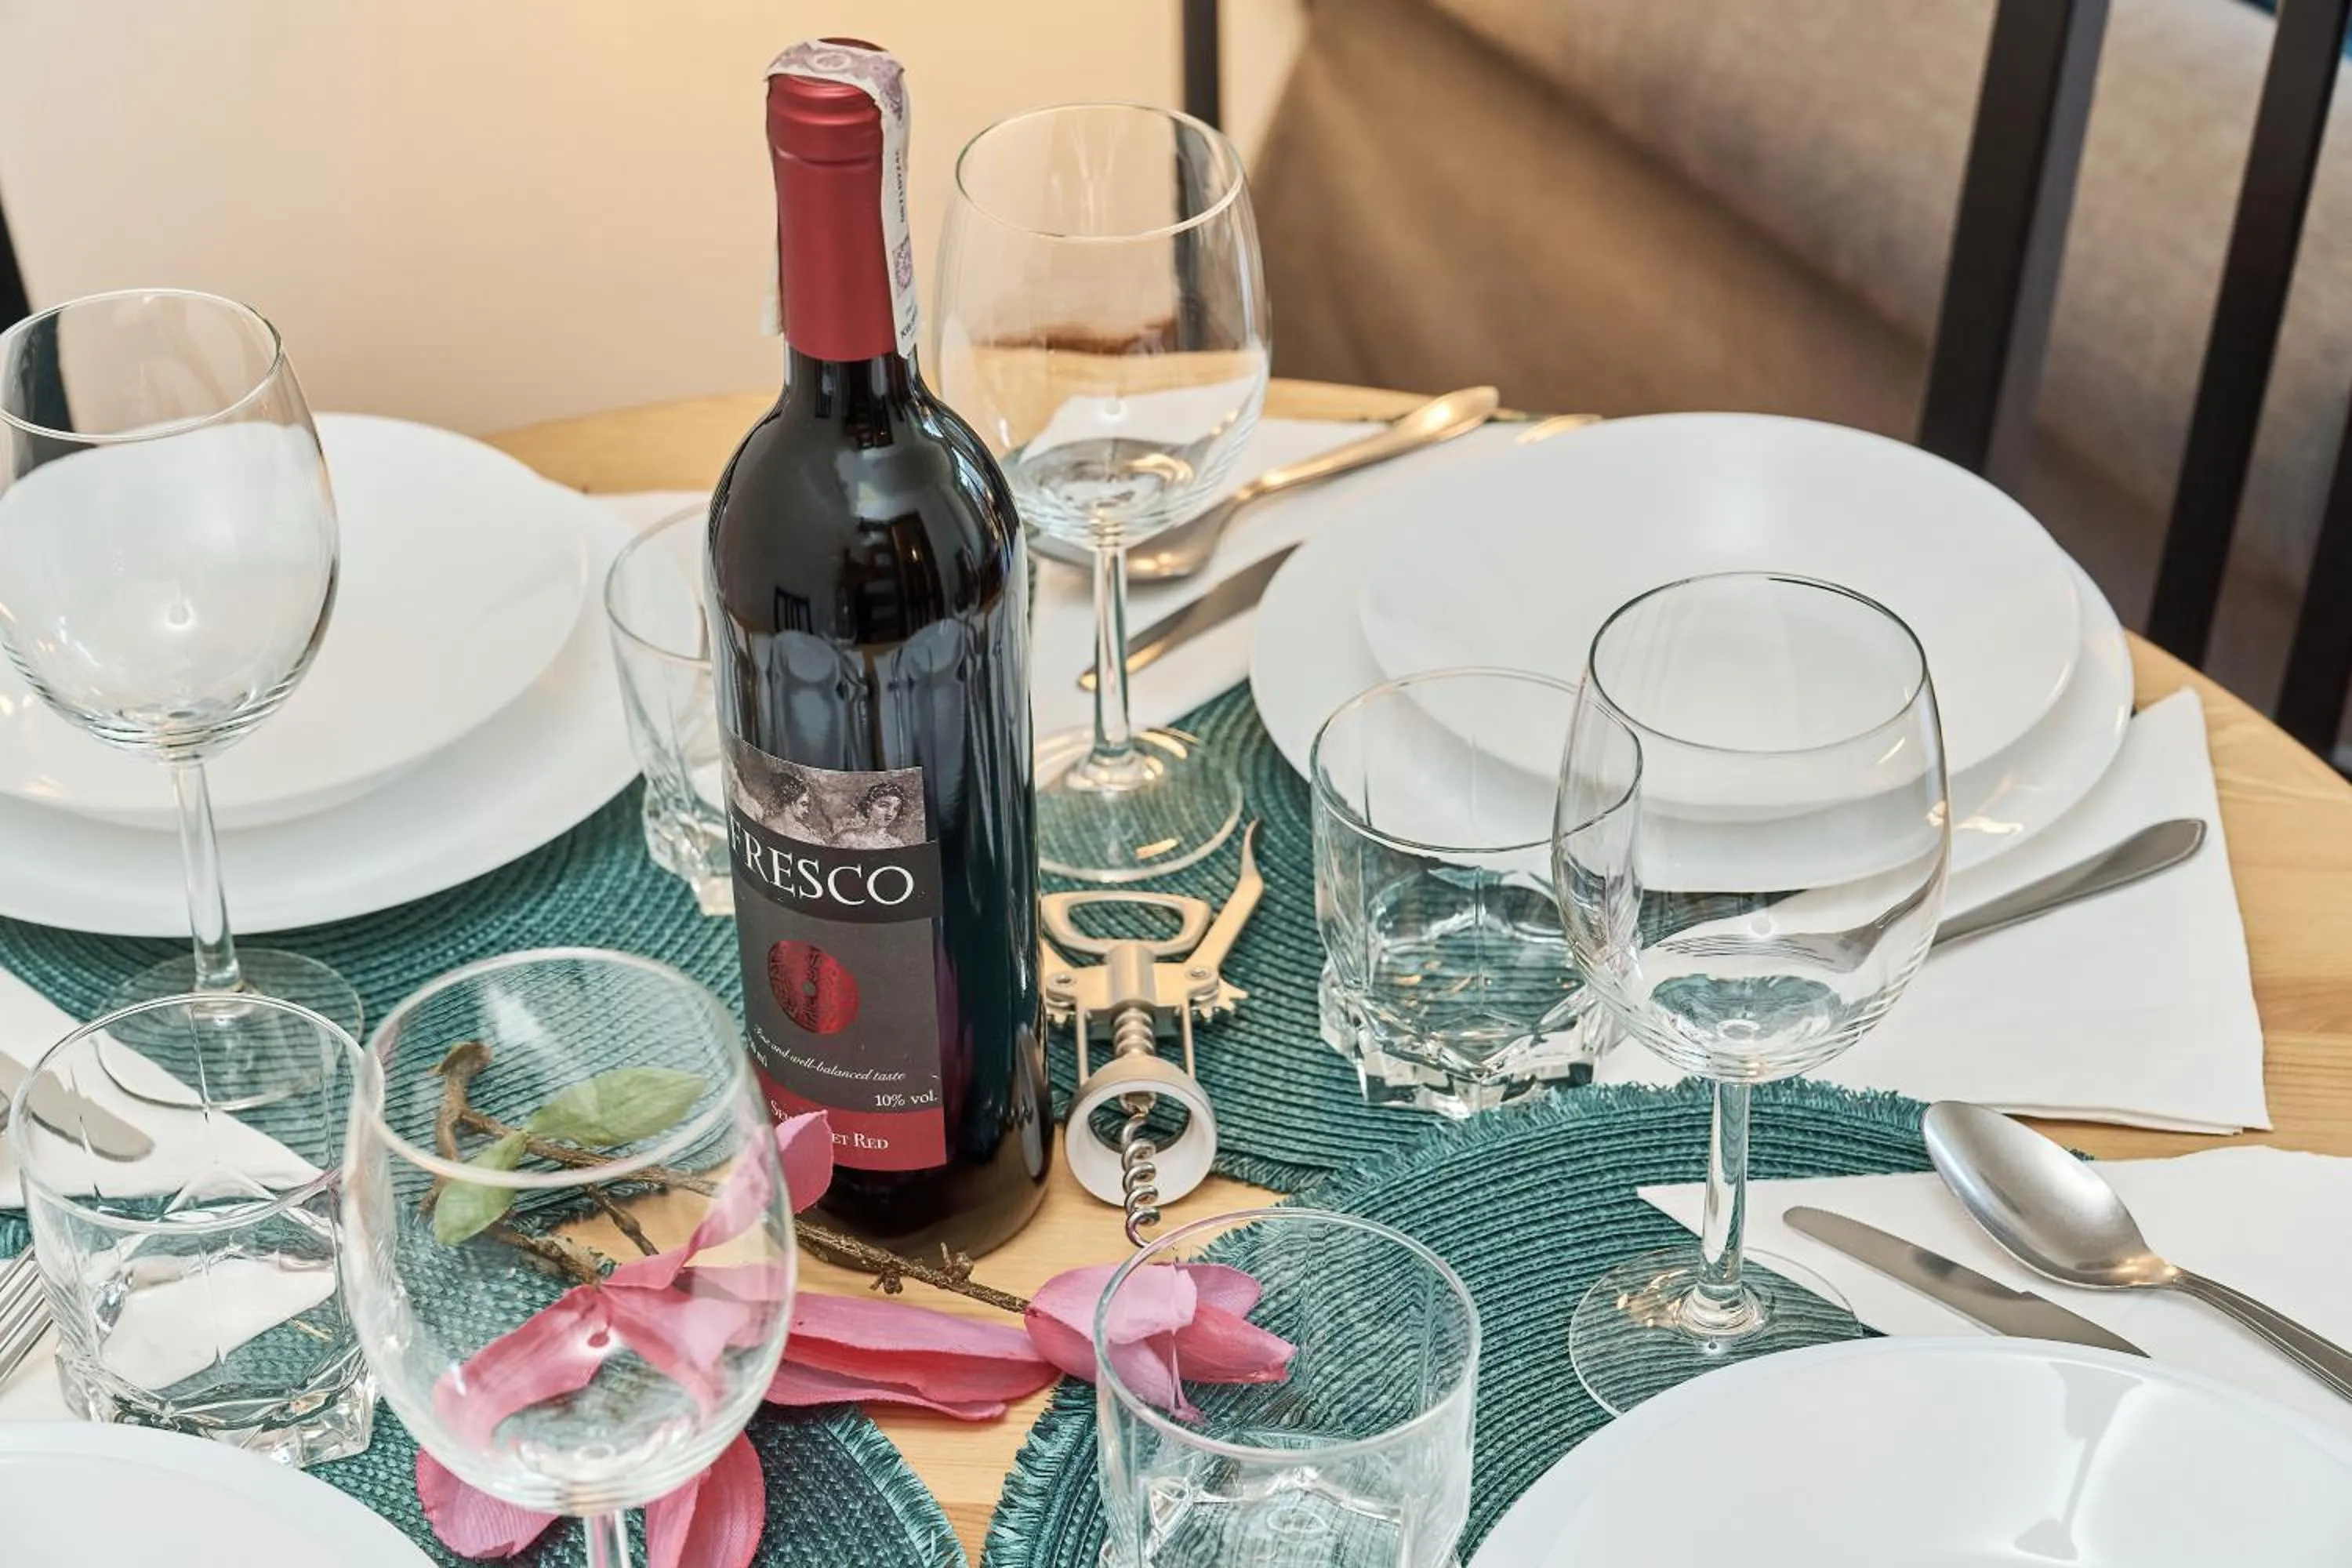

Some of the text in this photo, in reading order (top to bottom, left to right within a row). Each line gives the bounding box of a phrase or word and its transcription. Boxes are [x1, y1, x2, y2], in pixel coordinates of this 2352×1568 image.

[728, 810, 915, 906] FRESCO
[771, 1043, 791, 1058] and
[789, 1055, 873, 1081] well-balanced
[873, 1071, 906, 1081] taste
[874, 1089, 938, 1106] 10% vol.
